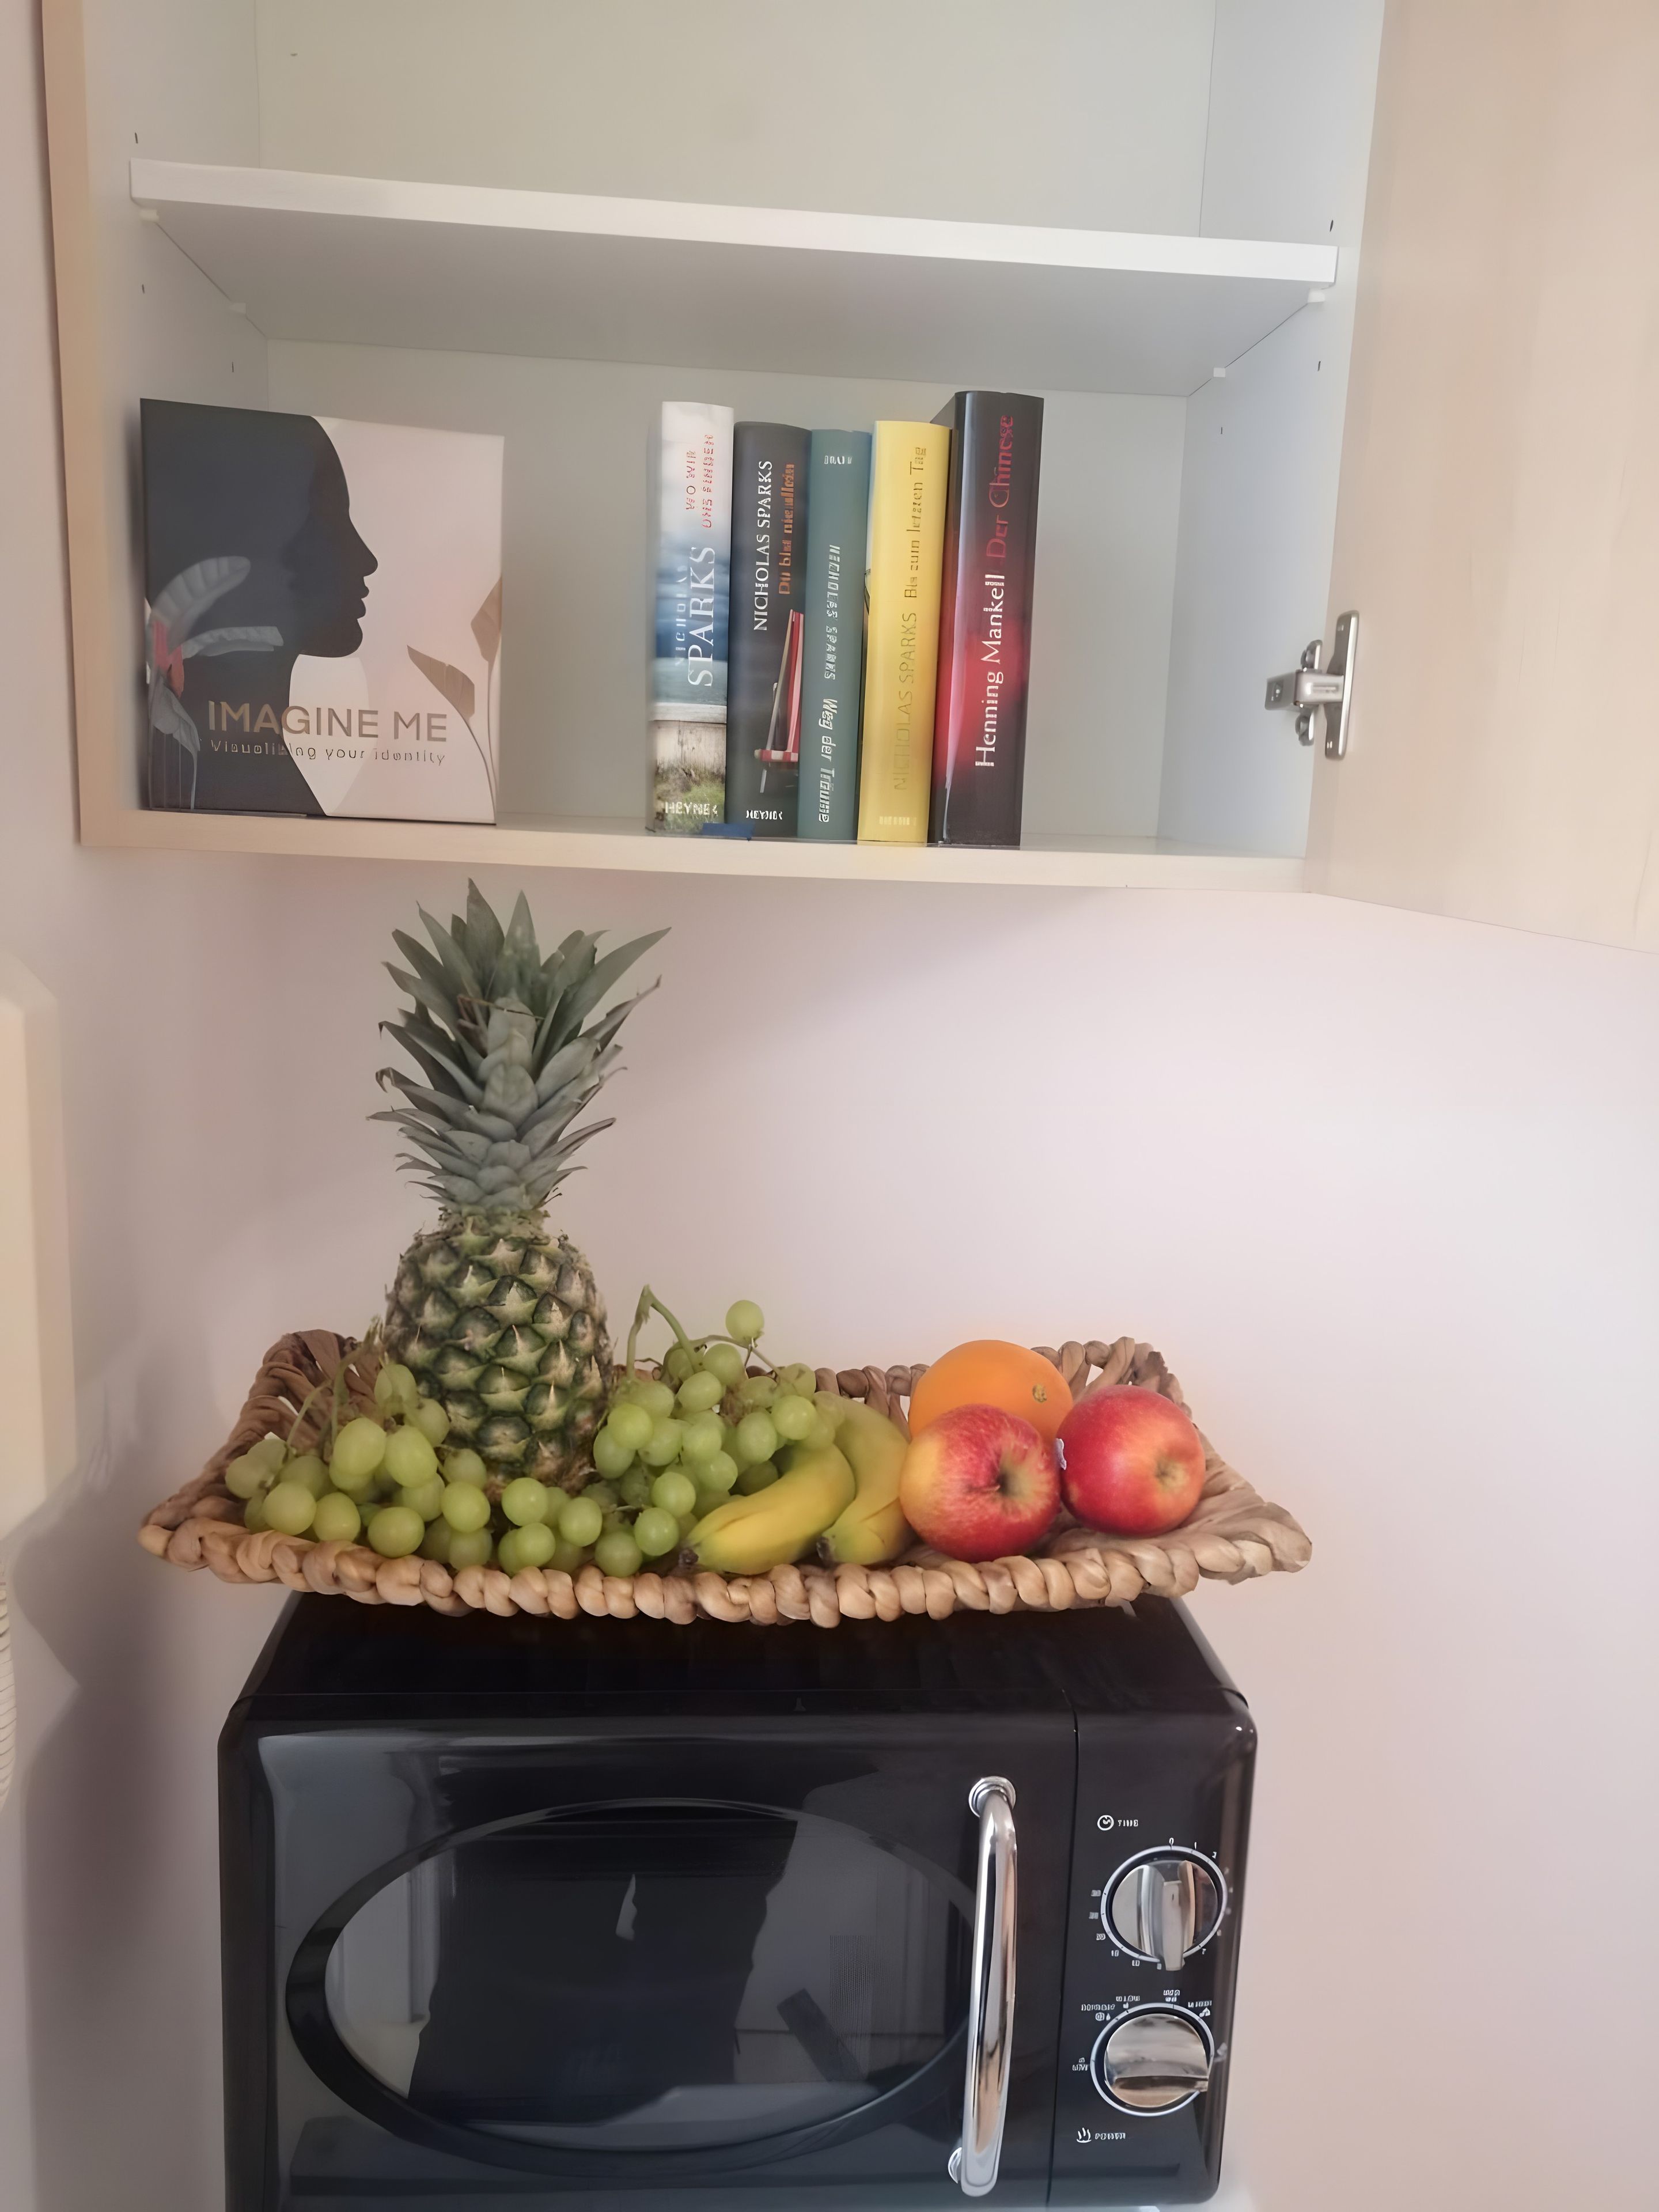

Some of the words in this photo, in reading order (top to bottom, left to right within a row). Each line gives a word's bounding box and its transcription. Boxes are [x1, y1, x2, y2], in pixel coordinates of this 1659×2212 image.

[757, 460, 772, 529] SPARKS
[988, 414, 1014, 508] Chinese
[986, 514, 1009, 558] Der
[687, 547, 715, 687] SPARKS
[753, 533, 770, 631] NICHOLAS
[899, 612, 917, 684] SPARKS
[980, 573, 1006, 664] Mankell
[208, 700, 379, 738] IMAGINE
[393, 711, 448, 743] ME
[818, 698, 838, 730] Weg
[821, 735, 836, 762] der
[893, 691, 913, 791] NICHOLAS
[975, 671, 1004, 767] Henning
[325, 748, 366, 760] your
[374, 748, 446, 767] identity
